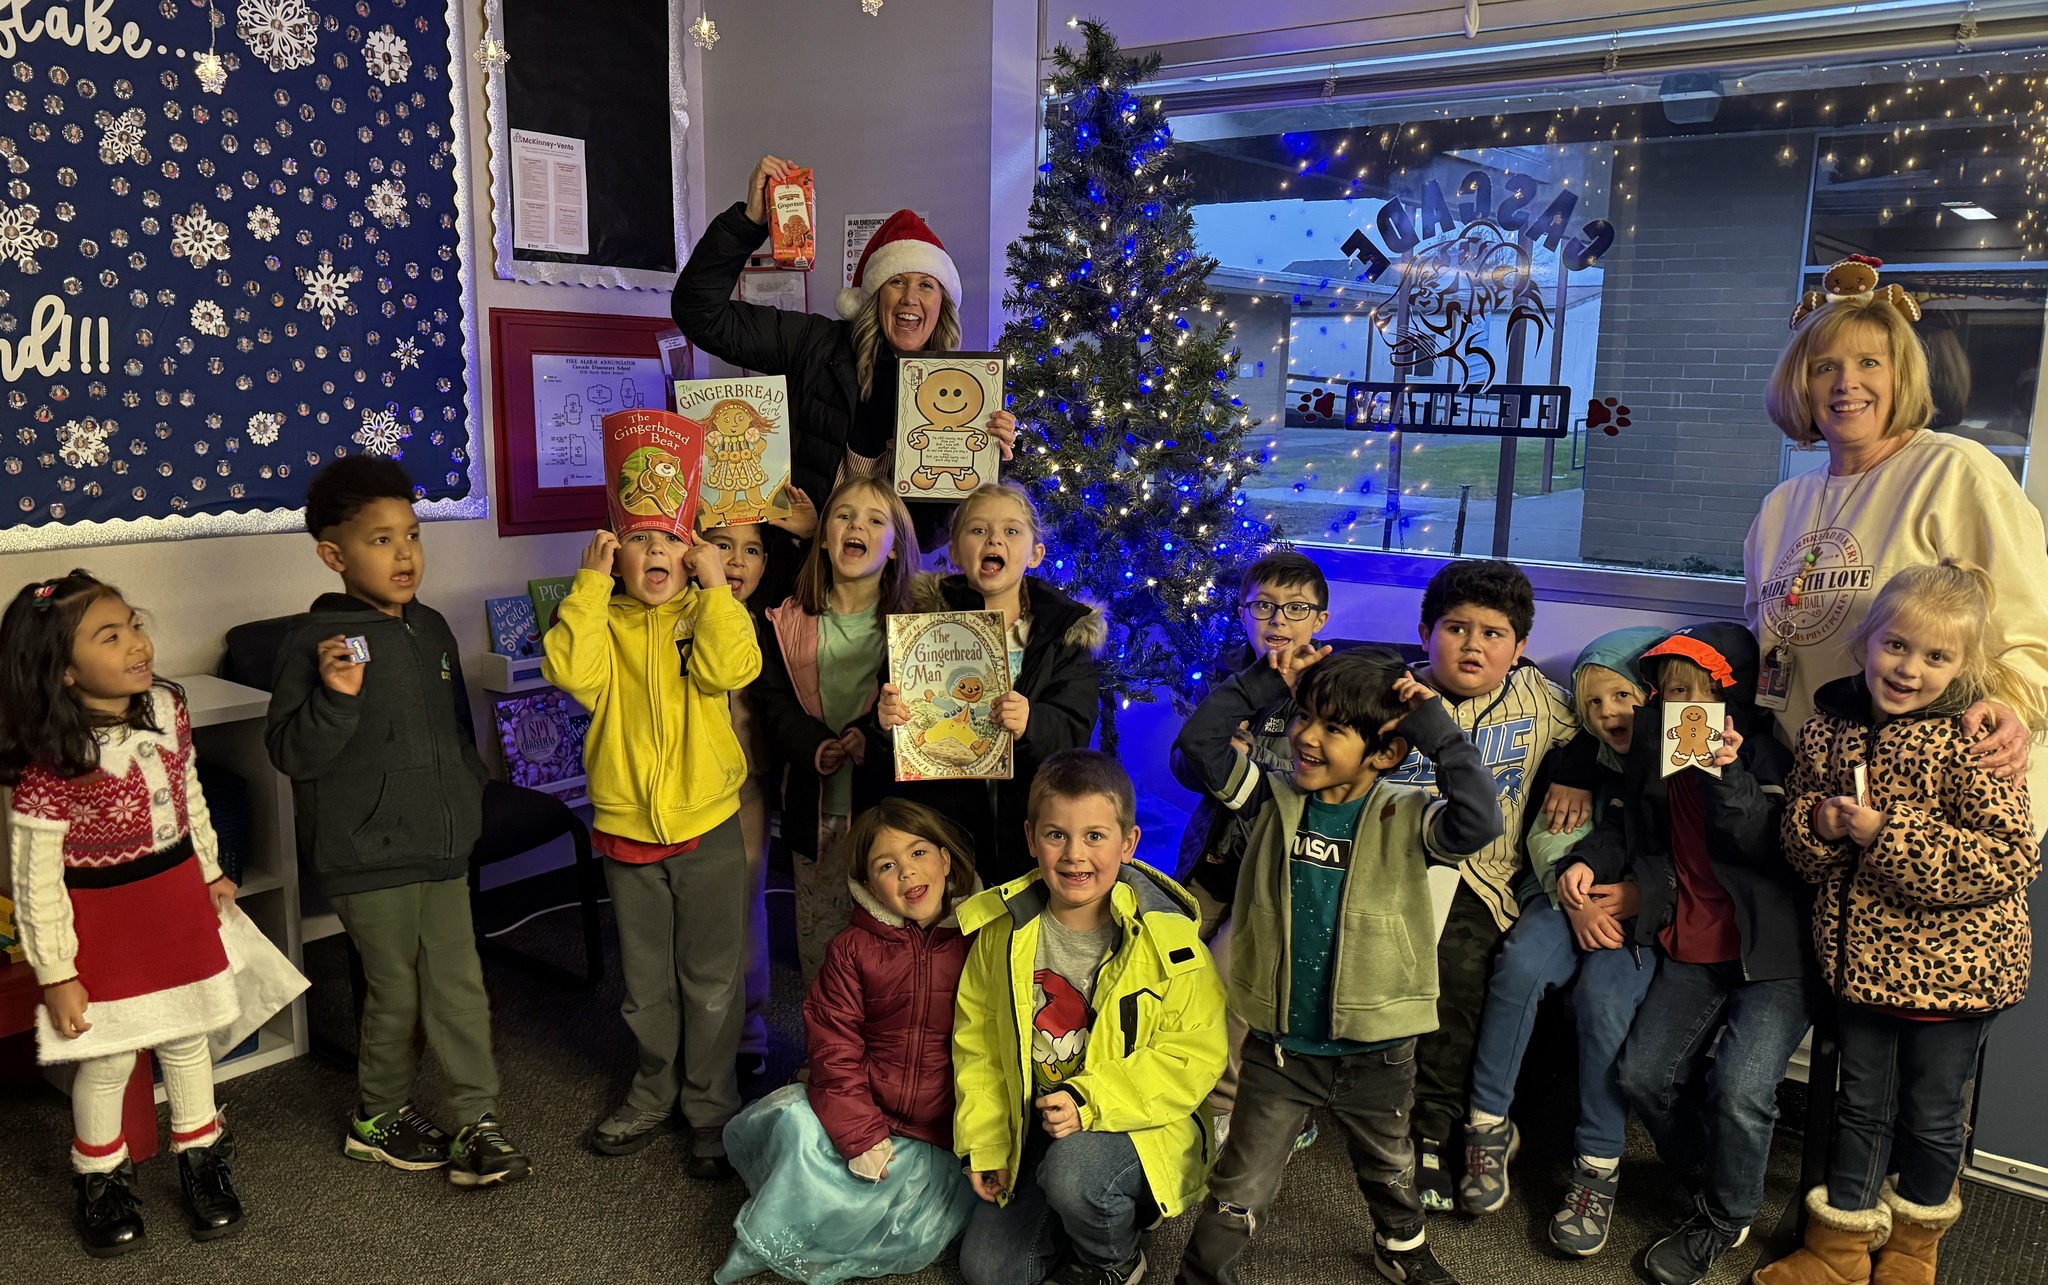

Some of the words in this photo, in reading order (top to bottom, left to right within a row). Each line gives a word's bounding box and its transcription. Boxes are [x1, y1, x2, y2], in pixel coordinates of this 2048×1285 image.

[522, 137, 575, 151] McKinney-Vento
[680, 384, 784, 410] GINGERBREAD
[758, 400, 781, 416] Girl
[628, 413, 650, 424] The
[614, 422, 690, 445] Gingerbread
[651, 432, 680, 451] Bear
[1775, 531, 1837, 577] GINGERBREAD
[1836, 533, 1858, 564] BAKERY
[1762, 577, 1789, 600] MADE
[1793, 572, 1826, 592] ITH
[1828, 570, 1871, 588] LOVE
[494, 600, 512, 617] How
[506, 600, 529, 627] Catch
[1780, 598, 1802, 612] FRH
[1804, 594, 1826, 609] DAILY
[1806, 630, 1821, 640] PIES
[1822, 593, 1848, 633] CUPCAKES
[930, 628, 950, 644] The
[914, 640, 983, 668] Gingerbread
[904, 664, 942, 691] Man
[521, 724, 526, 740] I
[529, 719, 552, 739] SPY
[521, 736, 556, 753] CHRISTMAS
[1293, 836, 1340, 863] NASA
